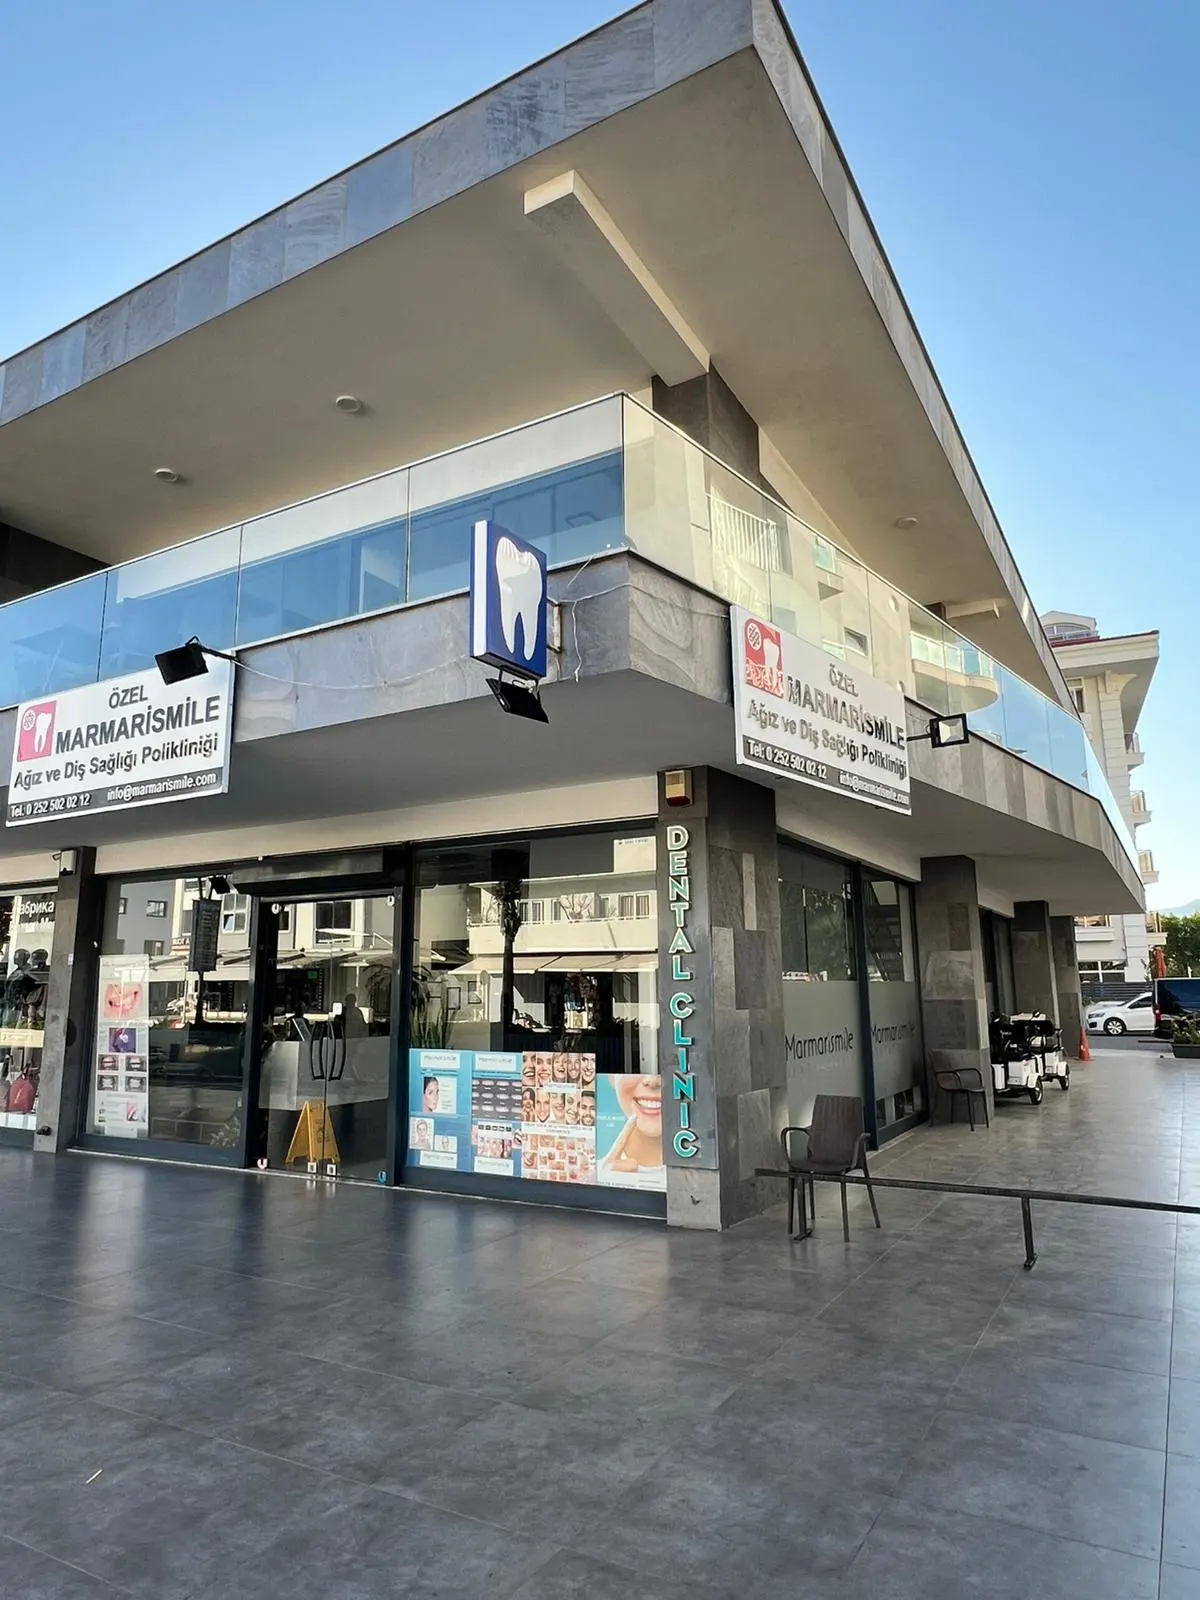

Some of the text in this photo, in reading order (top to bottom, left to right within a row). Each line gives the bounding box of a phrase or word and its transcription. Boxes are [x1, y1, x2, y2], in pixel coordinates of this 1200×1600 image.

[108, 685, 148, 709] ÖZEL
[829, 663, 859, 697] ÖZEL
[55, 695, 221, 754] MARMARİSMİLE
[747, 699, 908, 782] Ağız ve Diş Sağlığı Polikliniği
[787, 675, 906, 751] MARMARİSMİLE
[13, 733, 219, 791] Ağız ve Diş Sağlığı Polikliniği
[766, 746, 773, 761] 0
[774, 749, 790, 767] 252
[790, 754, 806, 772] 502
[806, 761, 817, 776] 02
[817, 765, 828, 780] 12
[26, 803, 32, 815] 0
[33, 800, 48, 814] 252
[49, 798, 65, 812] 502
[66, 795, 78, 808] 02
[80, 793, 91, 806] 12
[107, 773, 217, 801] info@marmarismile.com
[666, 825, 693, 981] DENTAL
[784, 1026, 854, 1061] Marmarismile
[669, 991, 699, 1158] CLINIC
